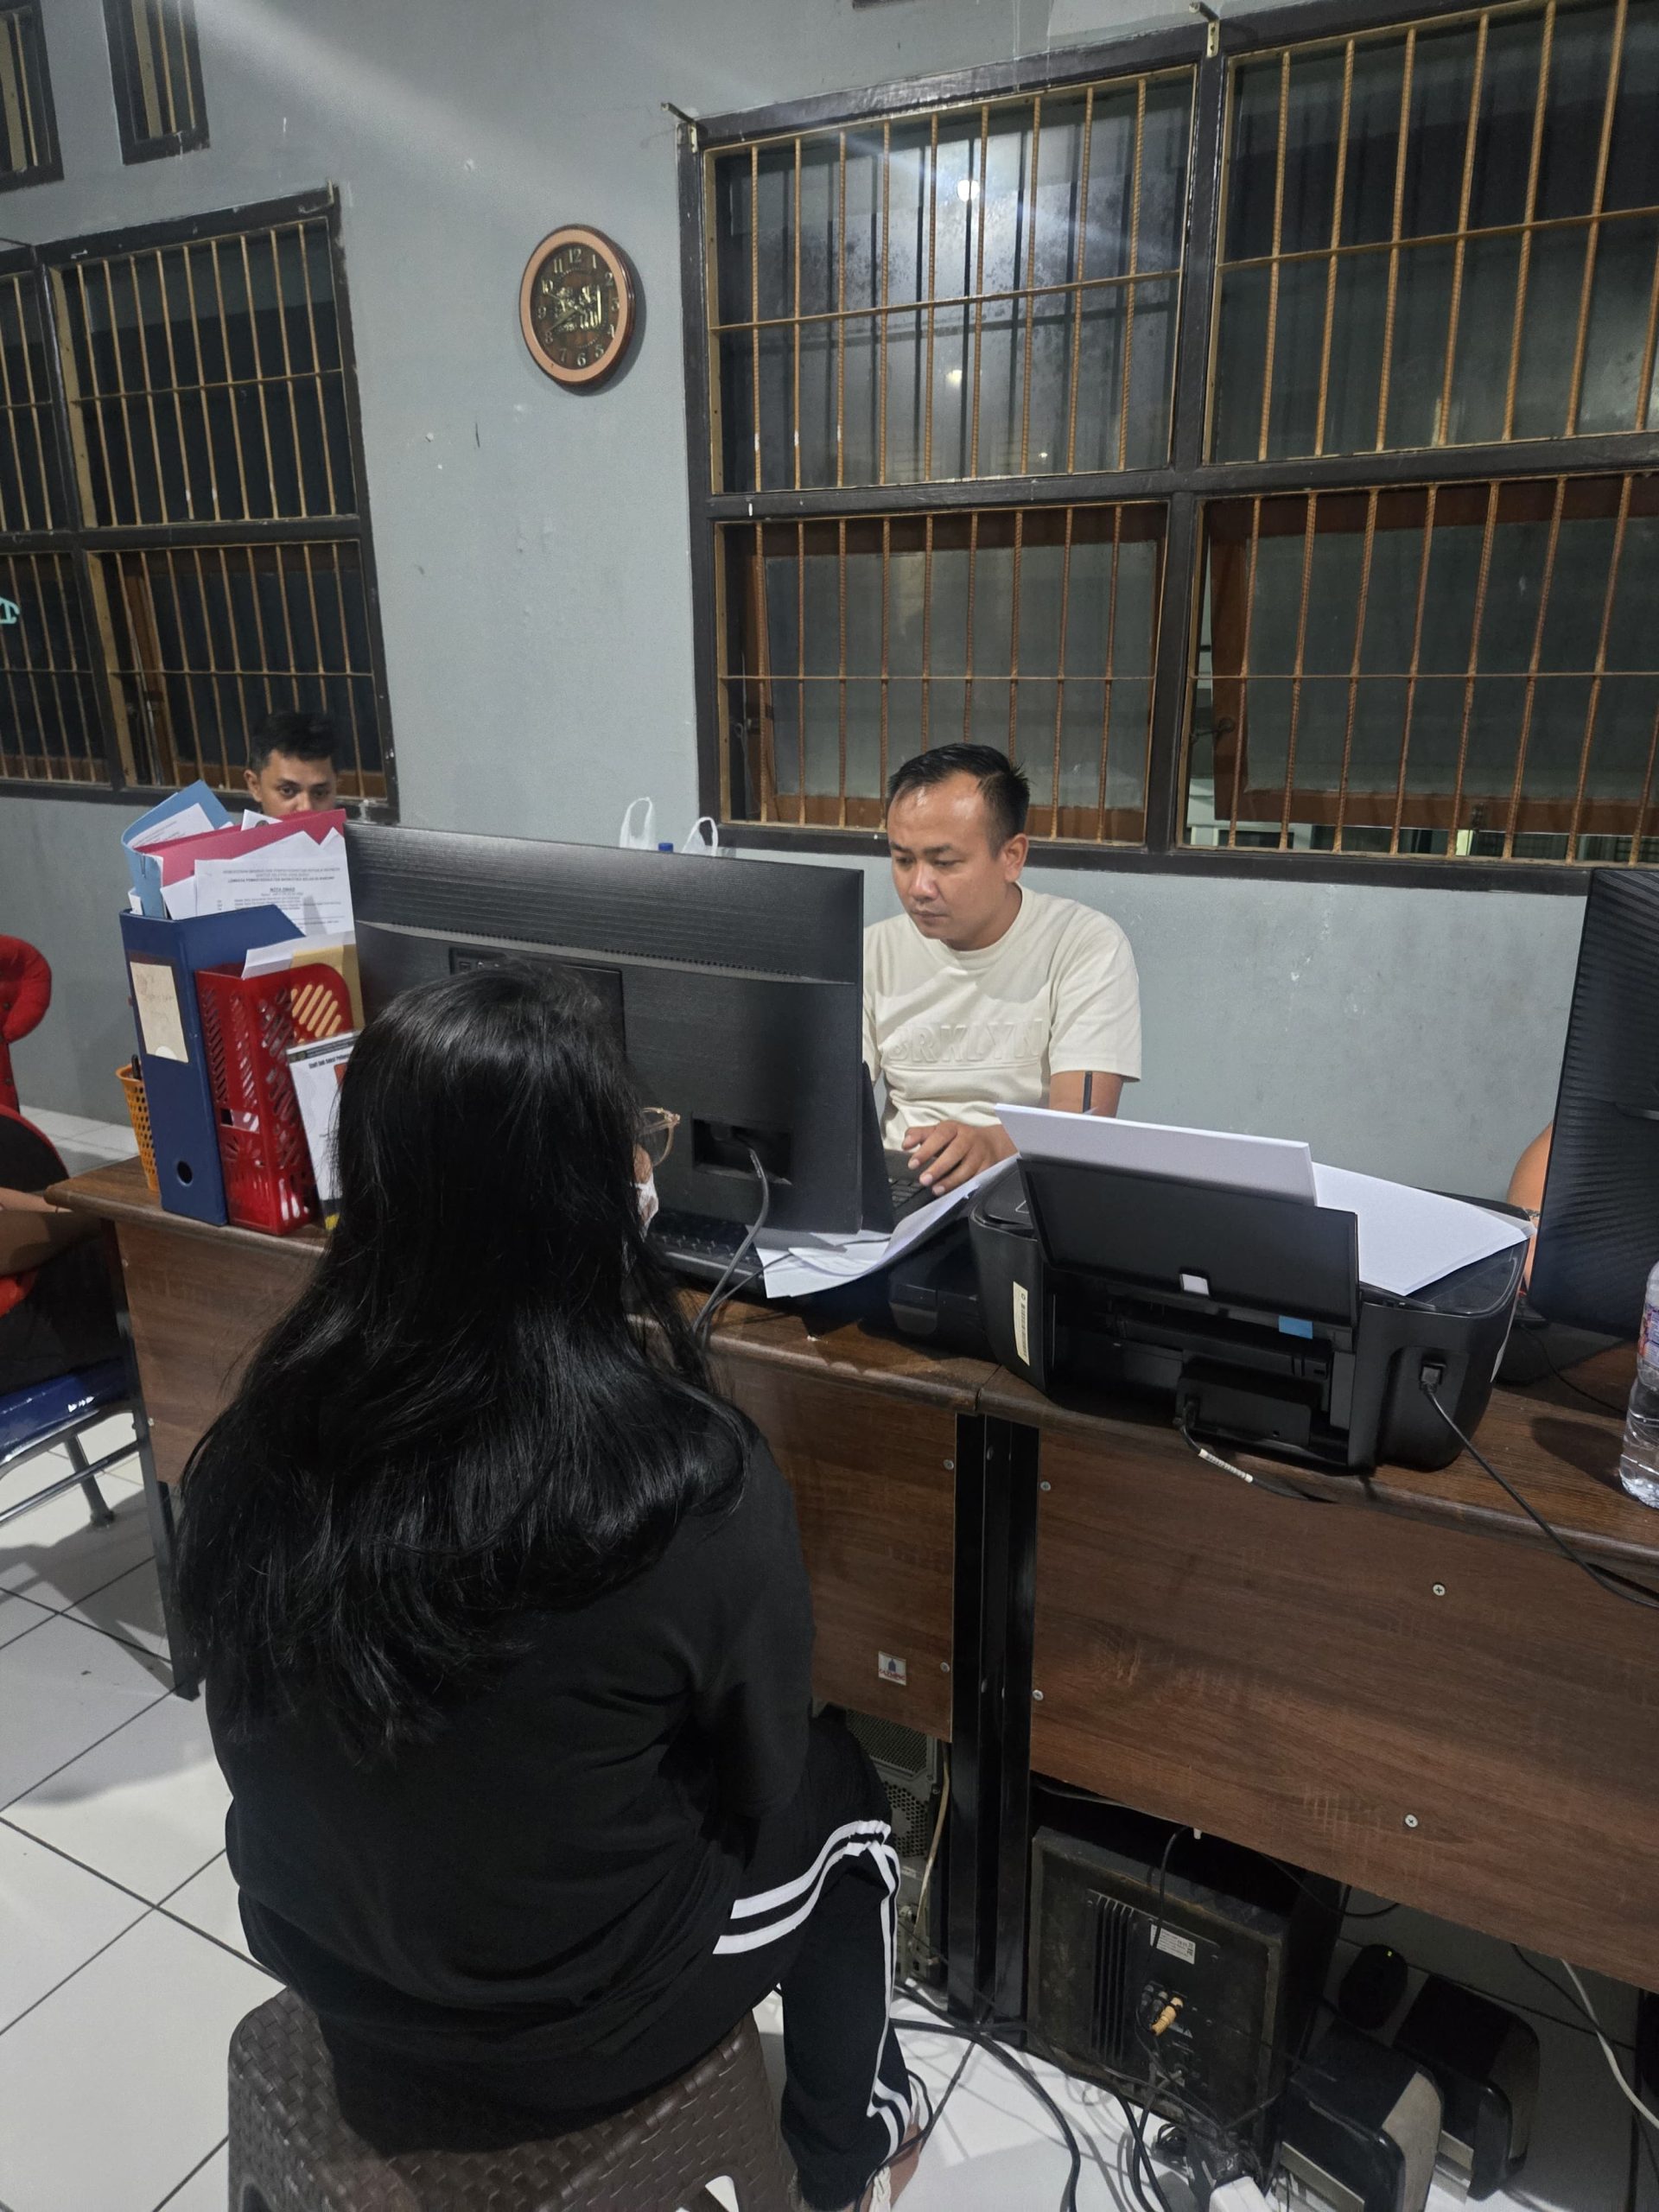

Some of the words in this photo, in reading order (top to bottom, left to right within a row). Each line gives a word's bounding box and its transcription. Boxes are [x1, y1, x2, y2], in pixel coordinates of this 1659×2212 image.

[569, 248, 582, 263] 12
[591, 254, 597, 269] 1
[554, 258, 563, 273] 11
[604, 272, 613, 286] 2
[611, 297, 620, 312] 3
[537, 307, 547, 319] 9
[544, 331, 554, 344] 8
[560, 347, 568, 362] 7
[594, 345, 604, 358] 5
[577, 353, 587, 367] 6
[887, 1019, 1044, 1063] BRKLYN
